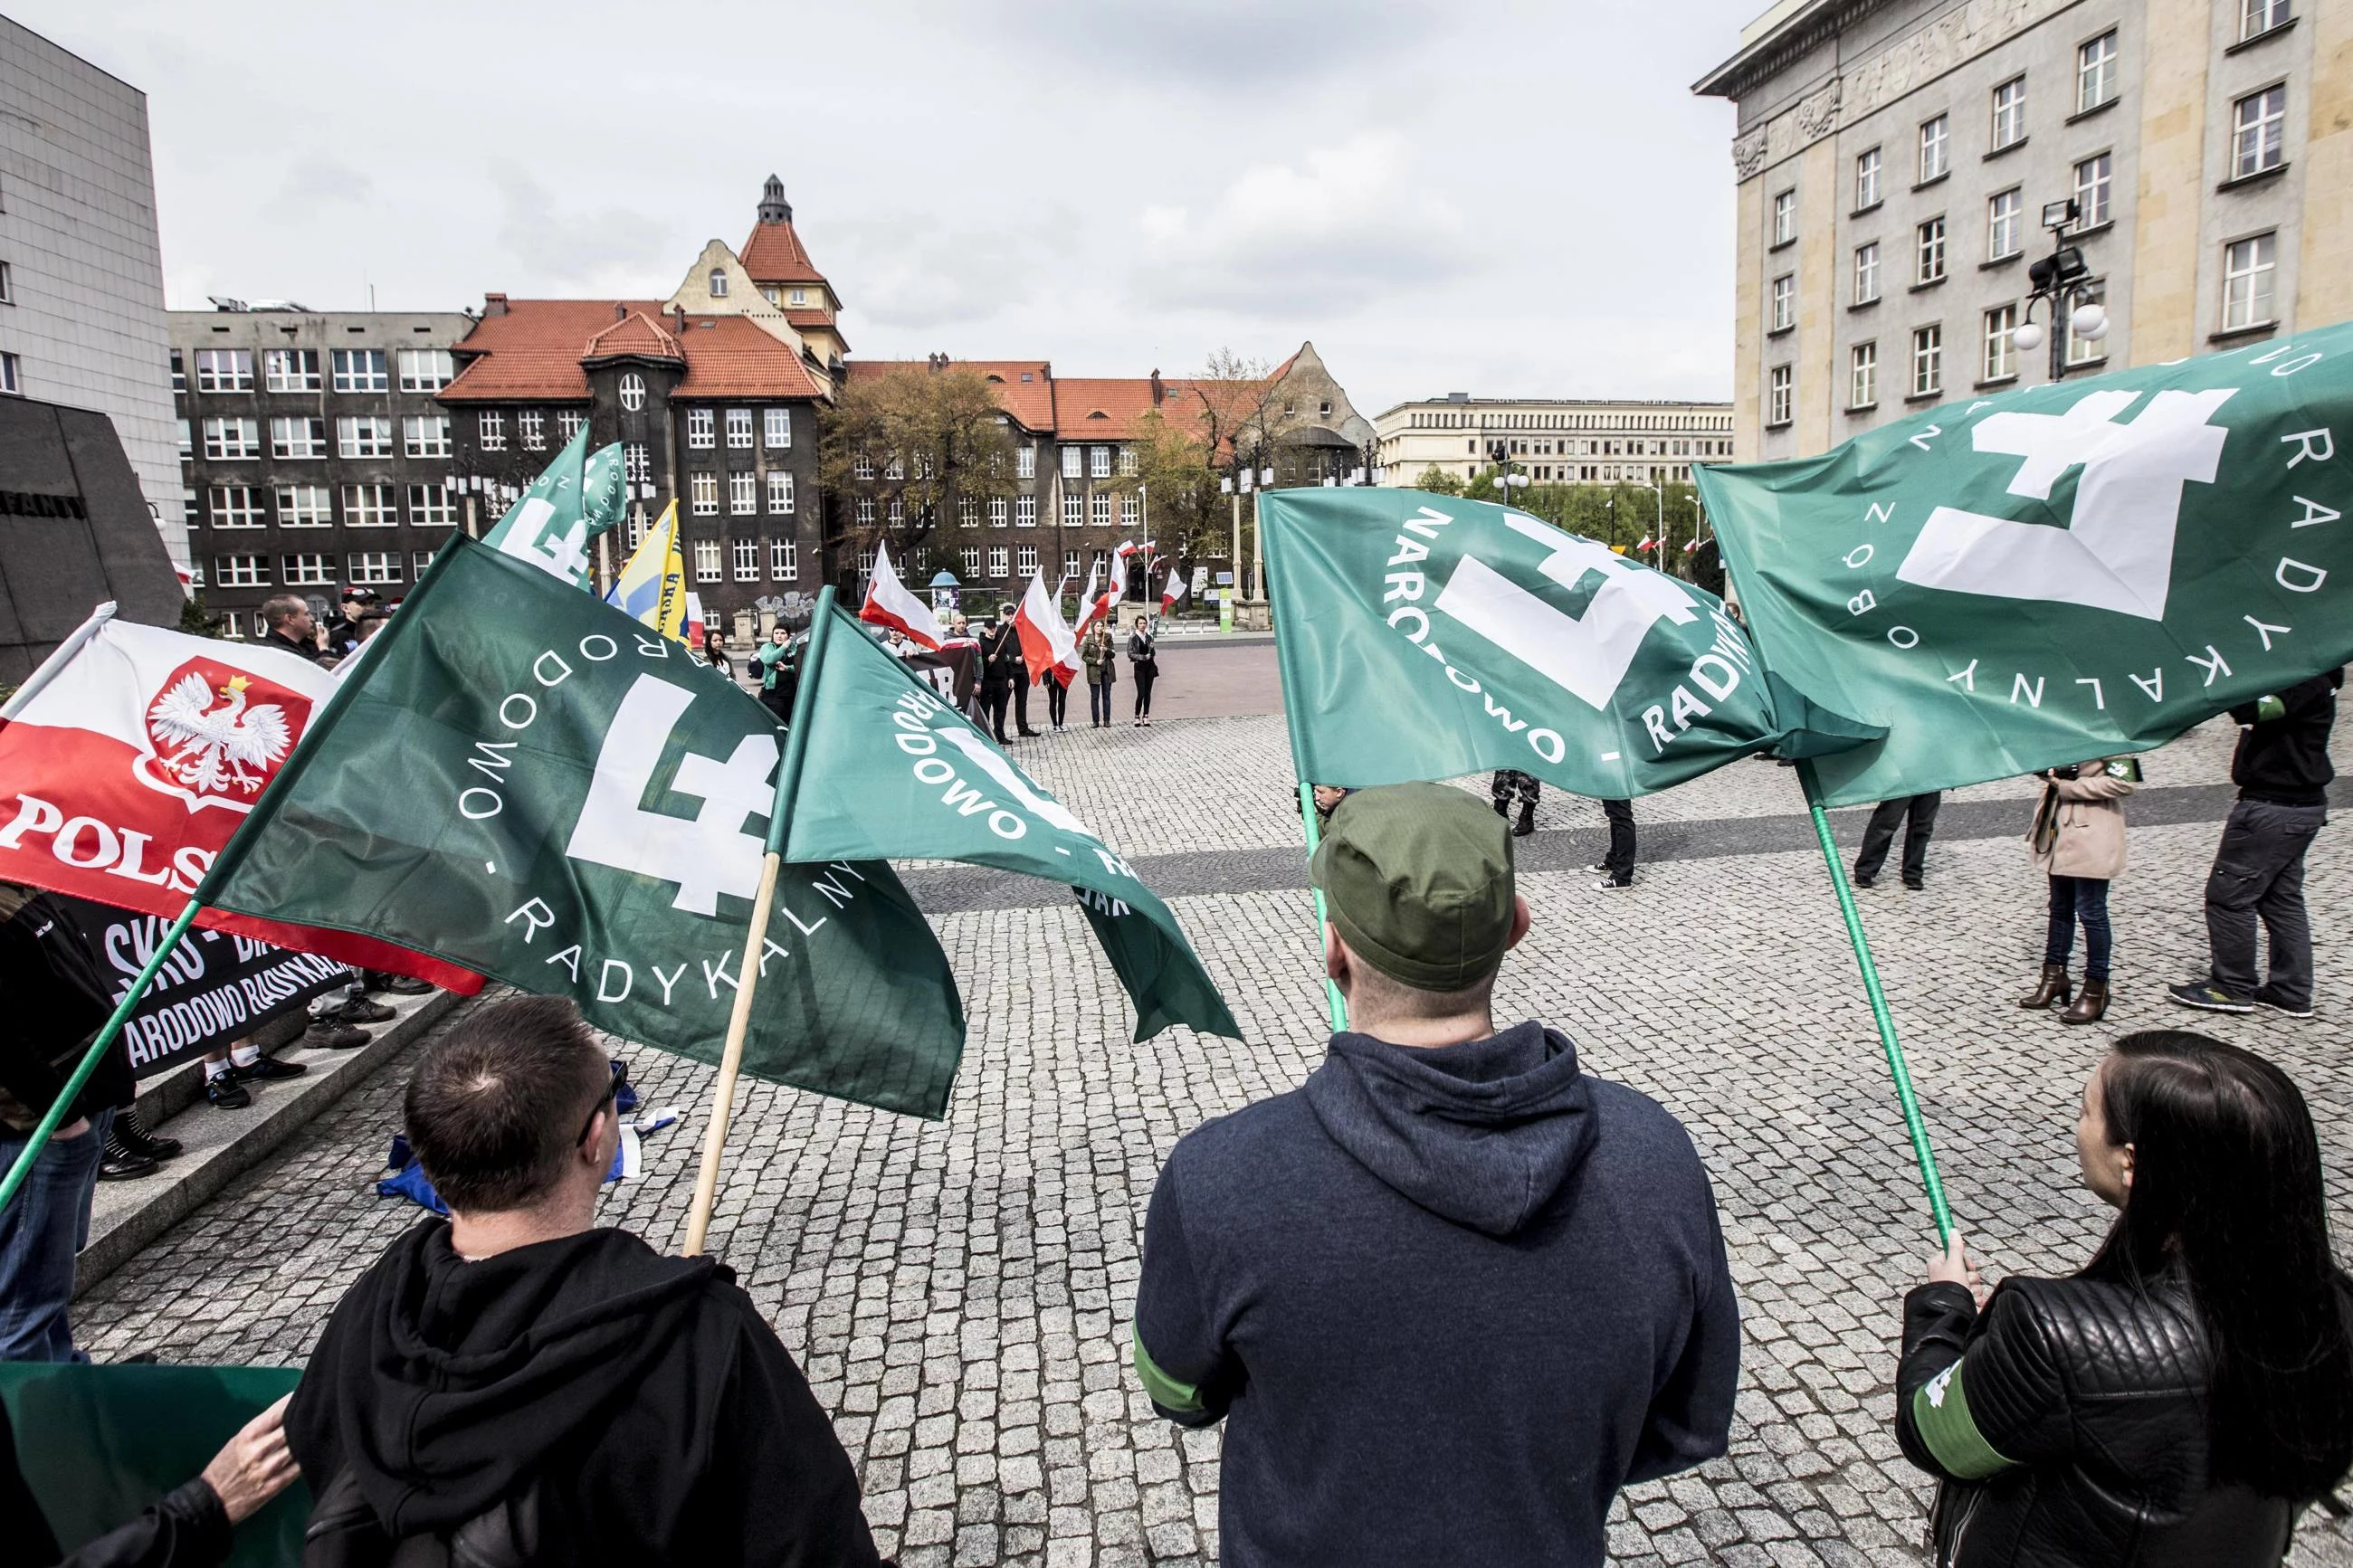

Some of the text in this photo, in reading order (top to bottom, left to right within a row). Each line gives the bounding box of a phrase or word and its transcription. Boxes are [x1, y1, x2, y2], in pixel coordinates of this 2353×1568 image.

[586, 451, 619, 526] ARODOWO
[1946, 428, 2341, 709] RADYKALNY
[459, 633, 711, 820] ARODOWO
[892, 689, 1027, 839] ARODOWO
[505, 860, 866, 1005] RADYKALNY
[124, 984, 247, 1069] ARODOWO
